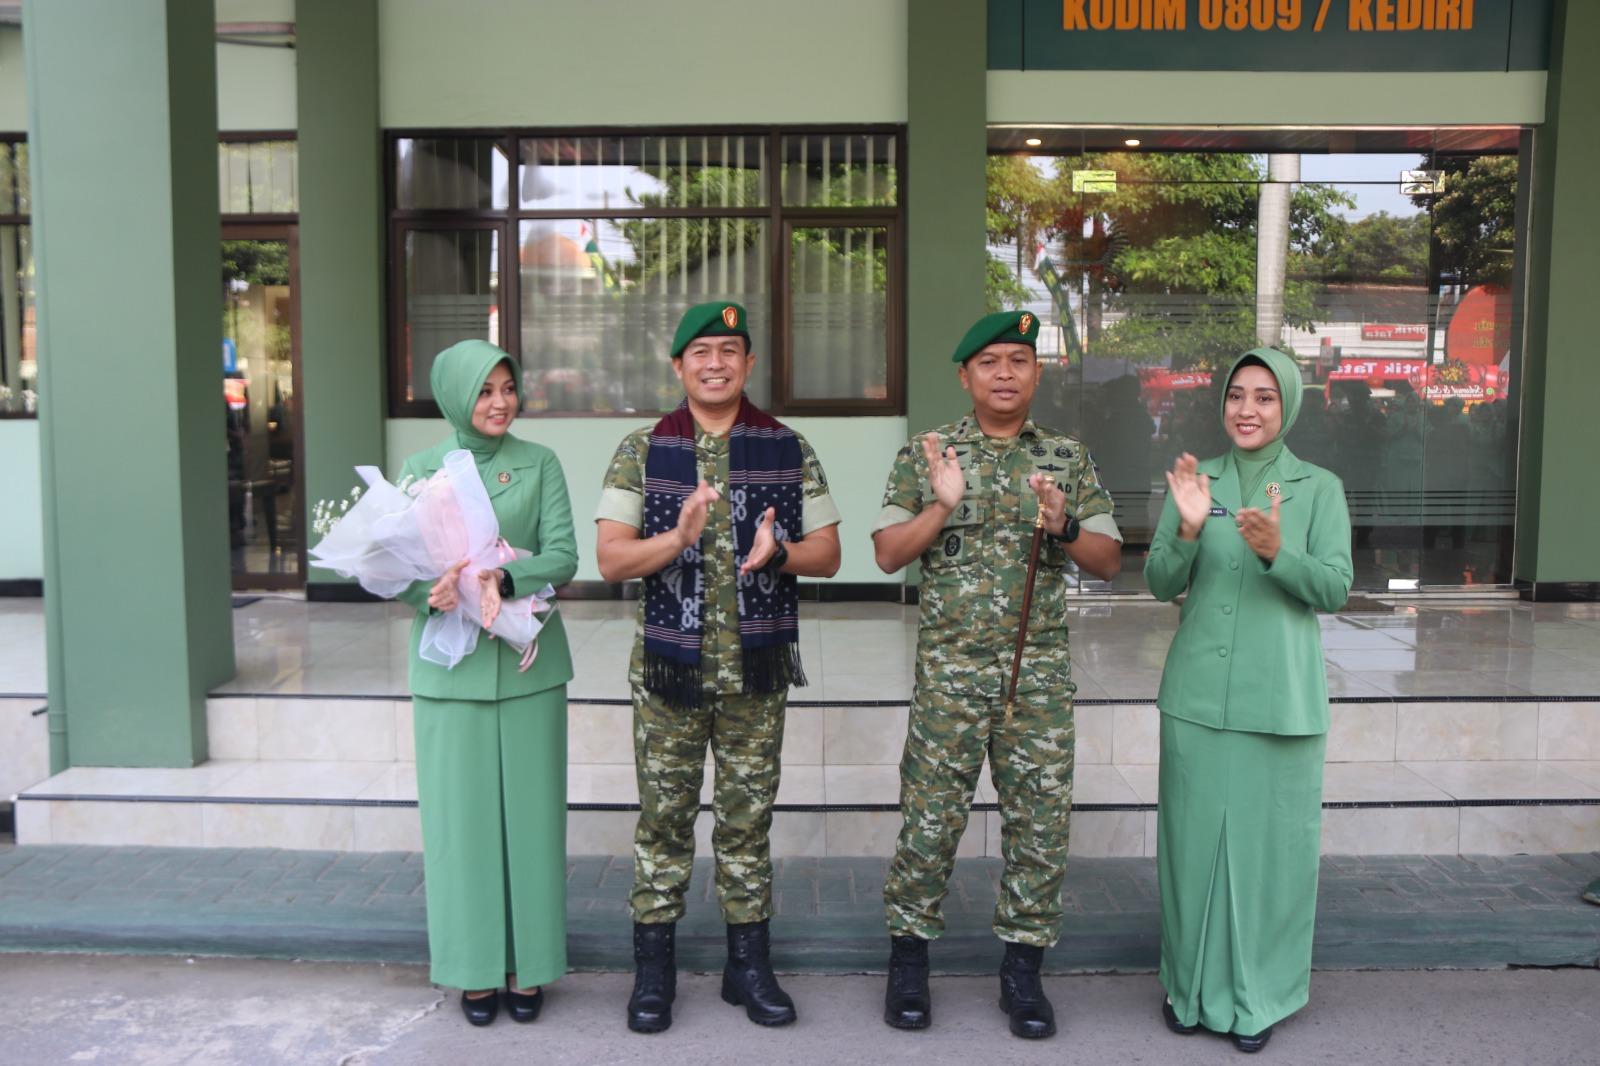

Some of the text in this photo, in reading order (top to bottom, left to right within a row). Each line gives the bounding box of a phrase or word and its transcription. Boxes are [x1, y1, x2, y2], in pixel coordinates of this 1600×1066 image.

[1063, 0, 1475, 32] KODIM 0809 / KEDIRI
